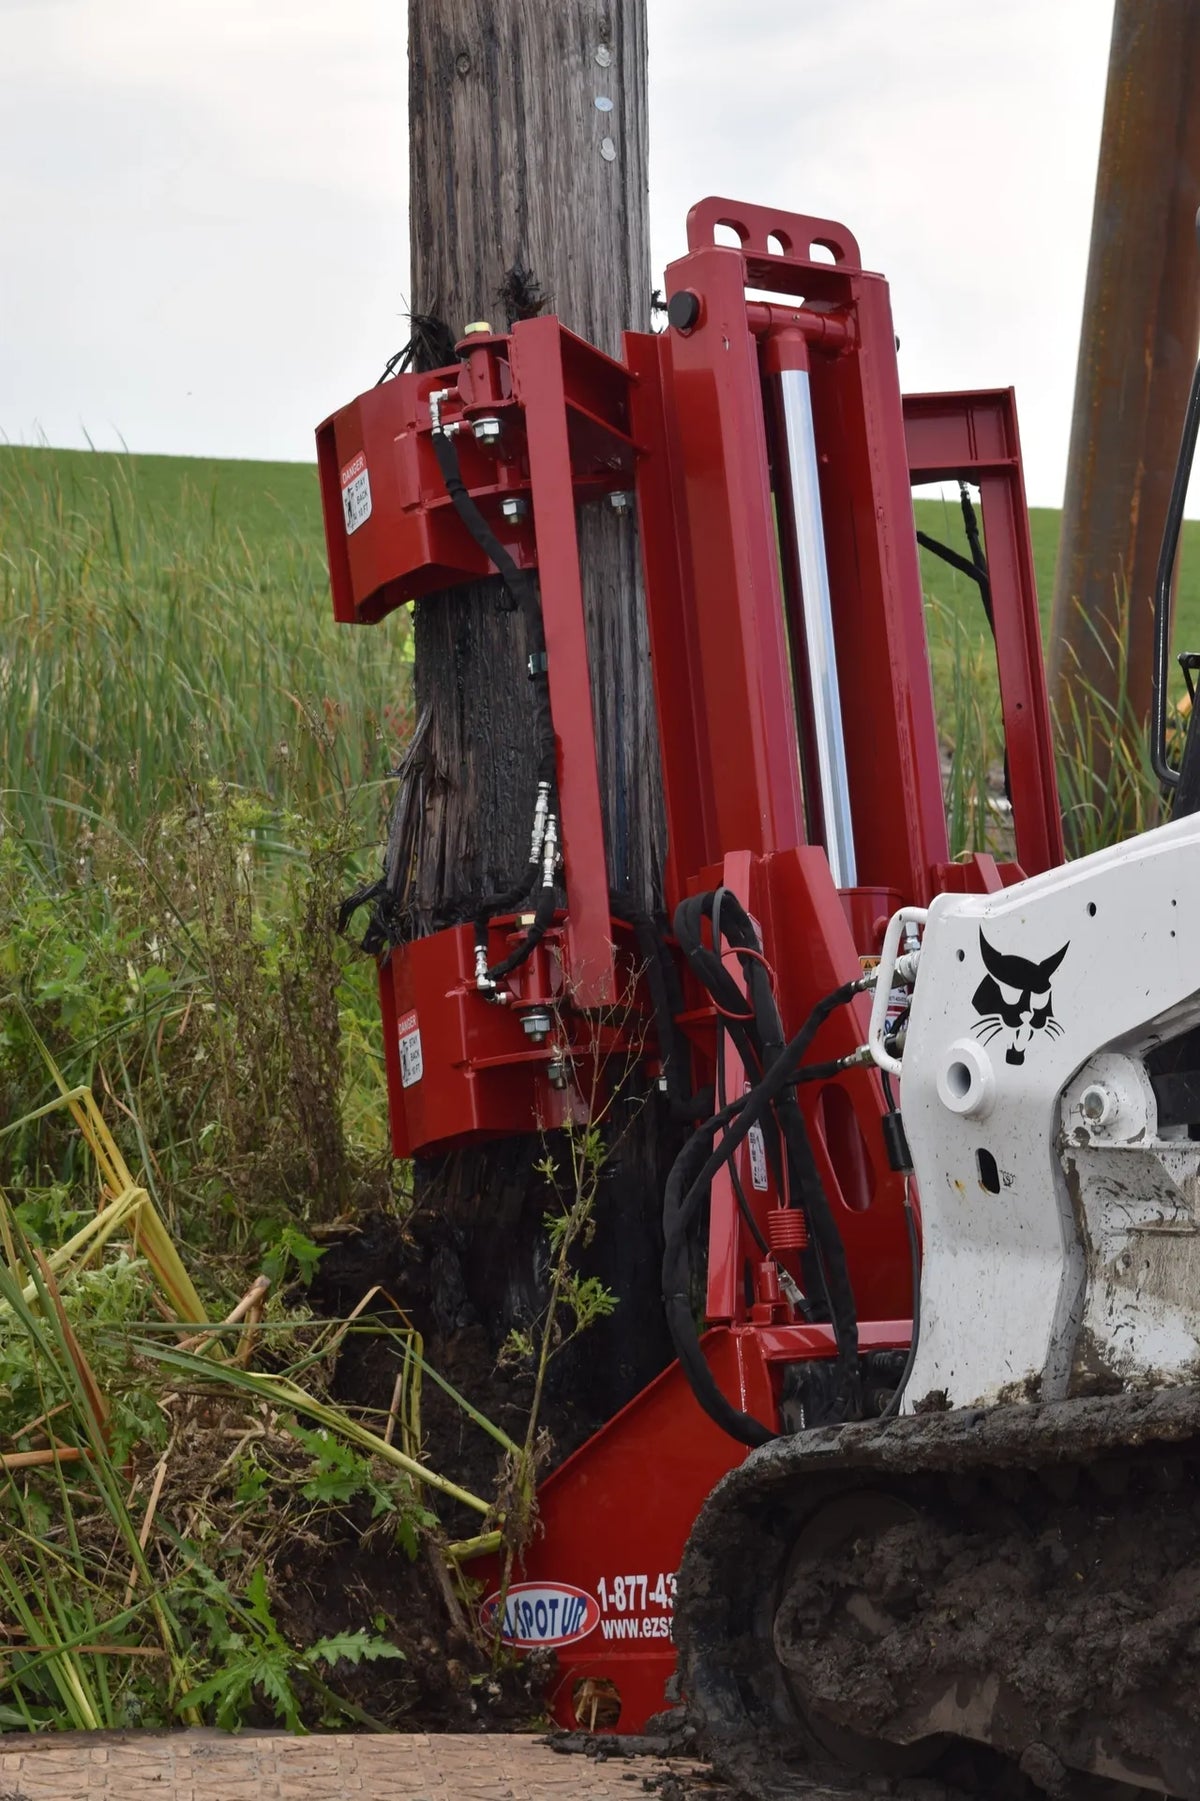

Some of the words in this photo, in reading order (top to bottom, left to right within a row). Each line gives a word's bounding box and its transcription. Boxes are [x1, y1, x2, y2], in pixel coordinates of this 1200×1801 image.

[342, 456, 364, 485] DANGER
[355, 477, 366, 491] STAY
[356, 490, 368, 504] BACK
